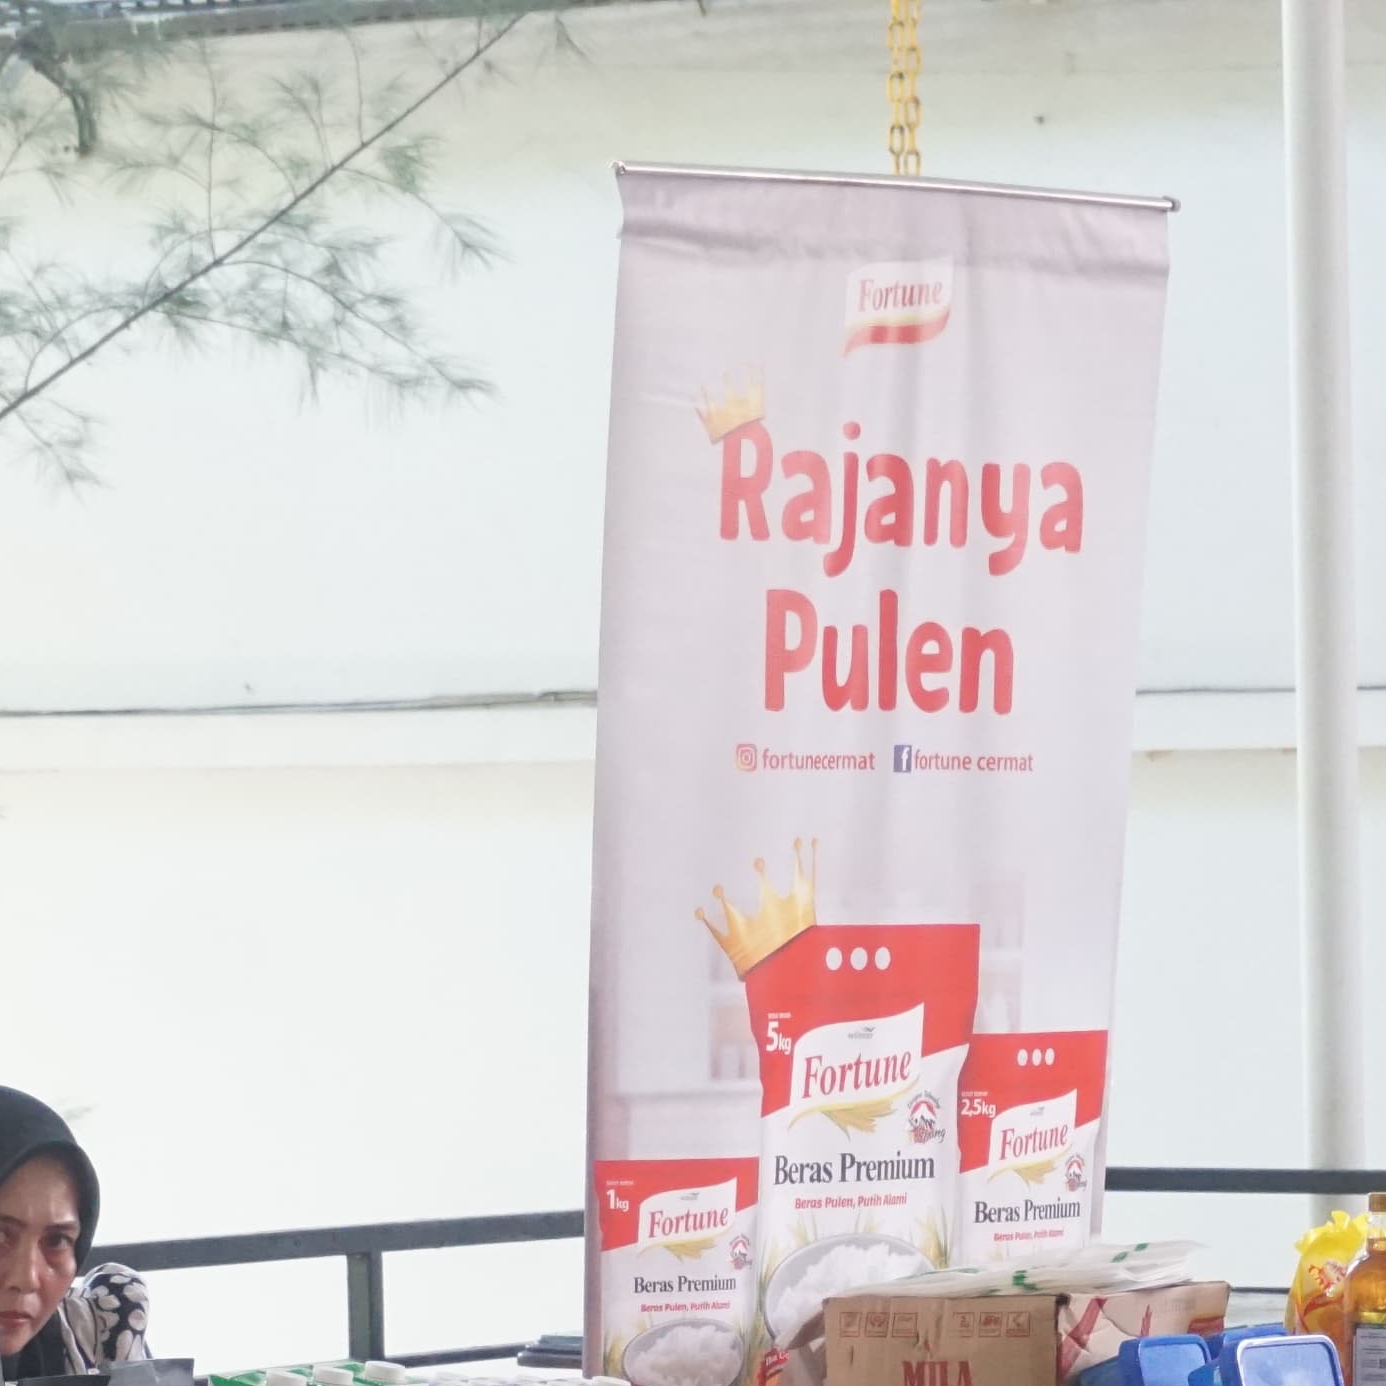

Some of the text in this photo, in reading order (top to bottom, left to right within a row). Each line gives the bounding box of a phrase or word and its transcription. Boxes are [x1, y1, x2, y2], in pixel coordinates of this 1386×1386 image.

[857, 274, 944, 312] Fortune
[719, 420, 1084, 578] Rajanya
[764, 589, 1015, 715] Pulen
[762, 749, 876, 772] fortunecermat
[914, 749, 1034, 773] fortune cermat
[766, 1021, 792, 1055] 5kg
[801, 1051, 912, 1099] Fortune
[960, 1098, 997, 1118] 2,5kg
[999, 1124, 1068, 1161] Fortune
[773, 1150, 935, 1185] Beras Premium
[606, 1189, 630, 1212] 1kg
[795, 1197, 823, 1209] Beras
[858, 1194, 881, 1207] Putih
[974, 1196, 1080, 1223] Beras Premium
[648, 1207, 729, 1239] Fortune
[633, 1274, 736, 1294] Beras Premium
[641, 1303, 663, 1313] Beras
